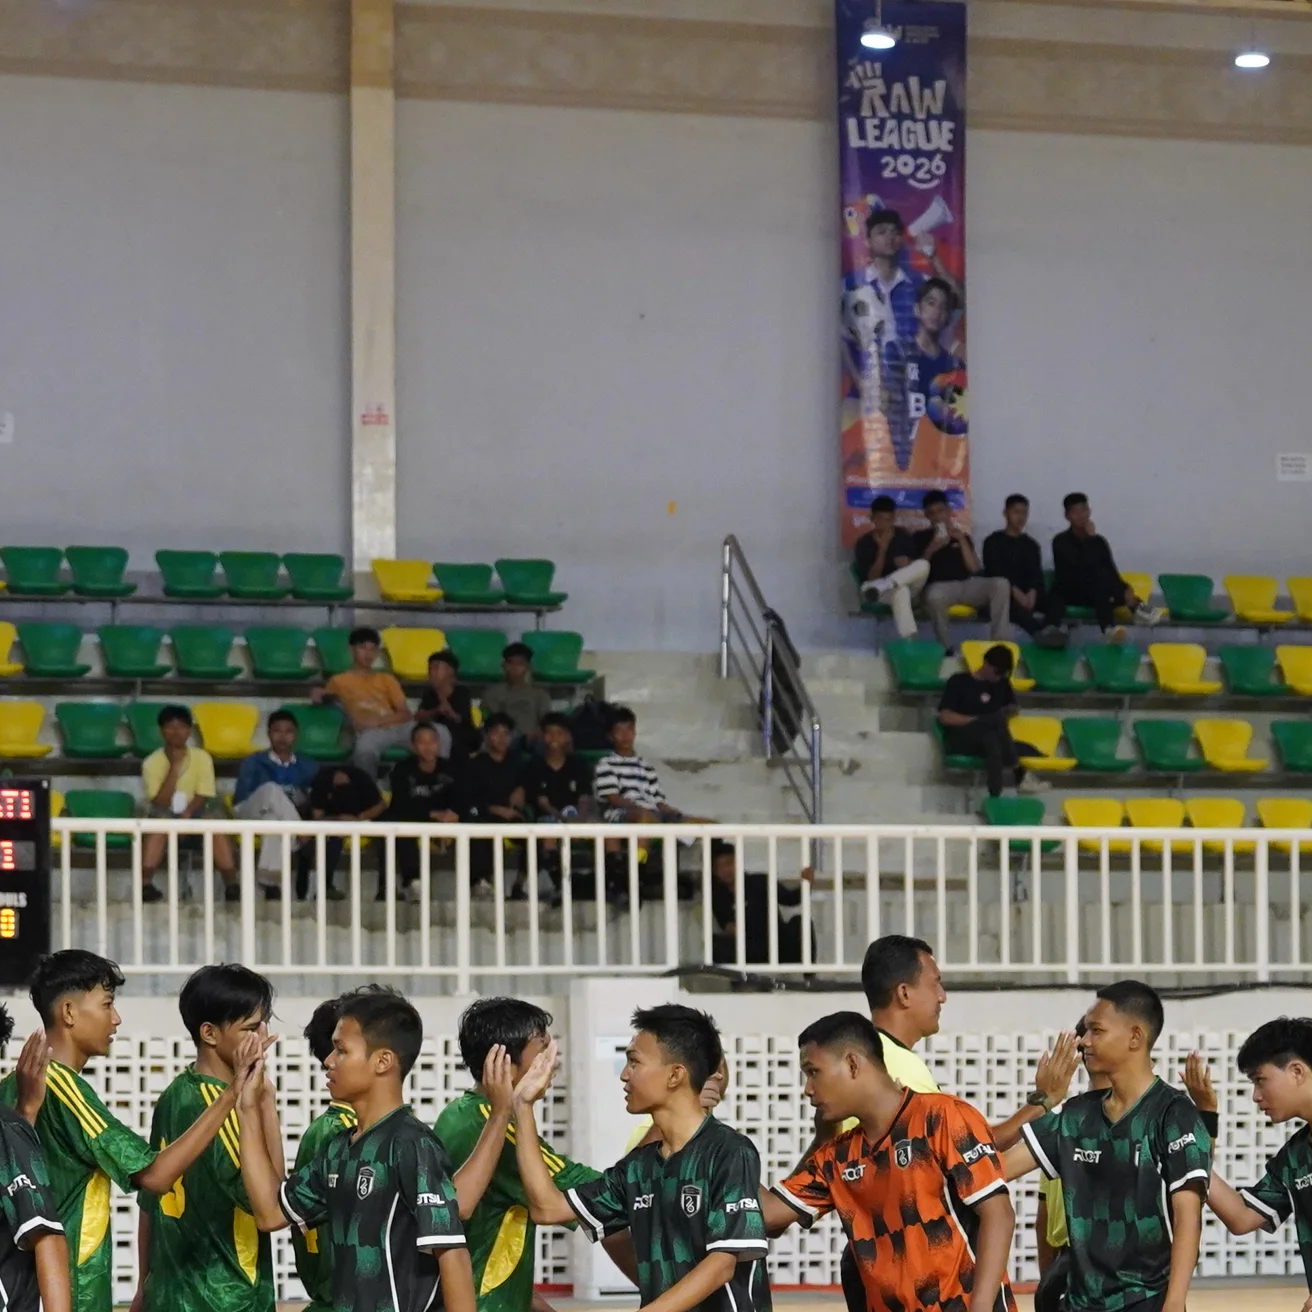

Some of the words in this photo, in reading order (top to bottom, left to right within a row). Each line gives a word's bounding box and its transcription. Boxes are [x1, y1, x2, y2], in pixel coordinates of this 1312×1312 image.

[860, 76, 947, 120] RAW
[846, 116, 955, 152] LEAGUE
[881, 153, 946, 179] 2026
[0, 840, 15, 870] 1
[963, 1142, 995, 1163] FUTAL
[1168, 1132, 1197, 1154] FUTSA
[726, 1197, 759, 1214] FUTSA
